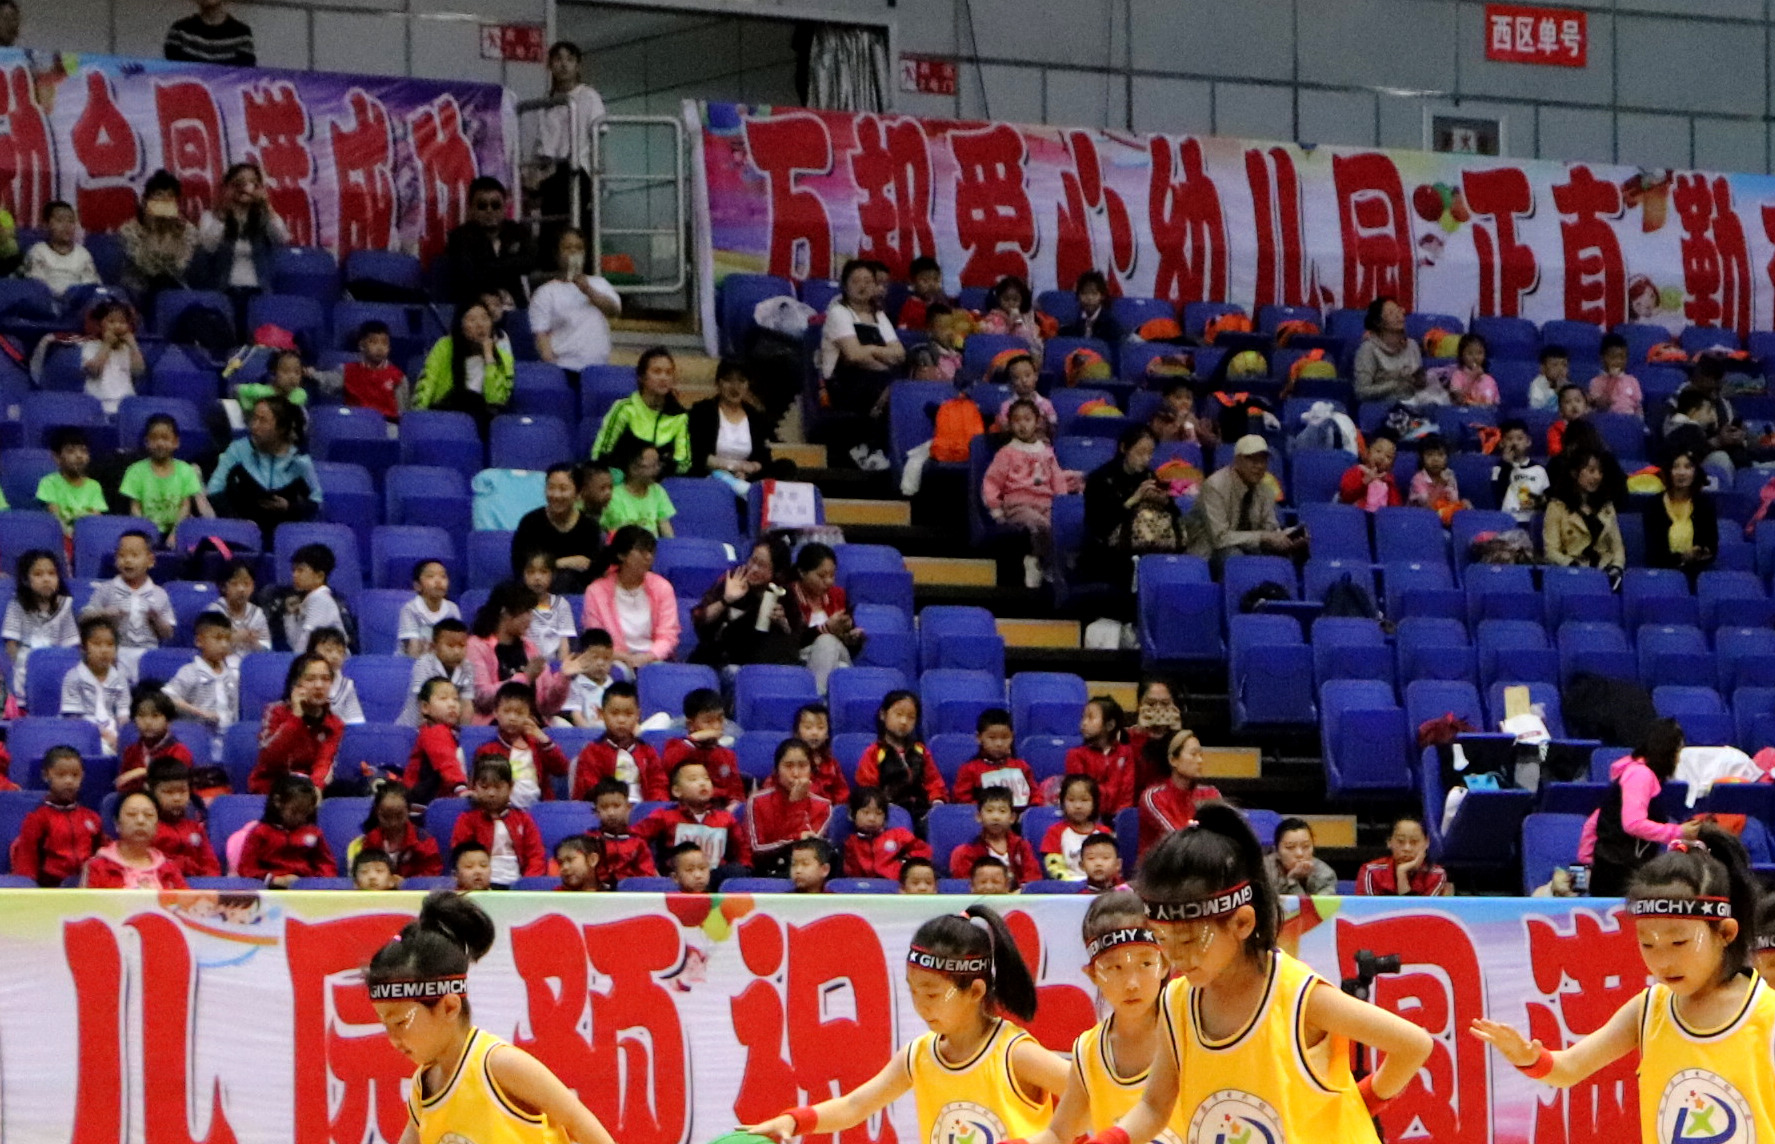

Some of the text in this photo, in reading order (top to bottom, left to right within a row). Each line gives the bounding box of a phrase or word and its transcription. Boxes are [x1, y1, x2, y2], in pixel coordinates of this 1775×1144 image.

[1490, 15, 1582, 57] 西区单号
[1156, 884, 1253, 921] GIVEMCHY
